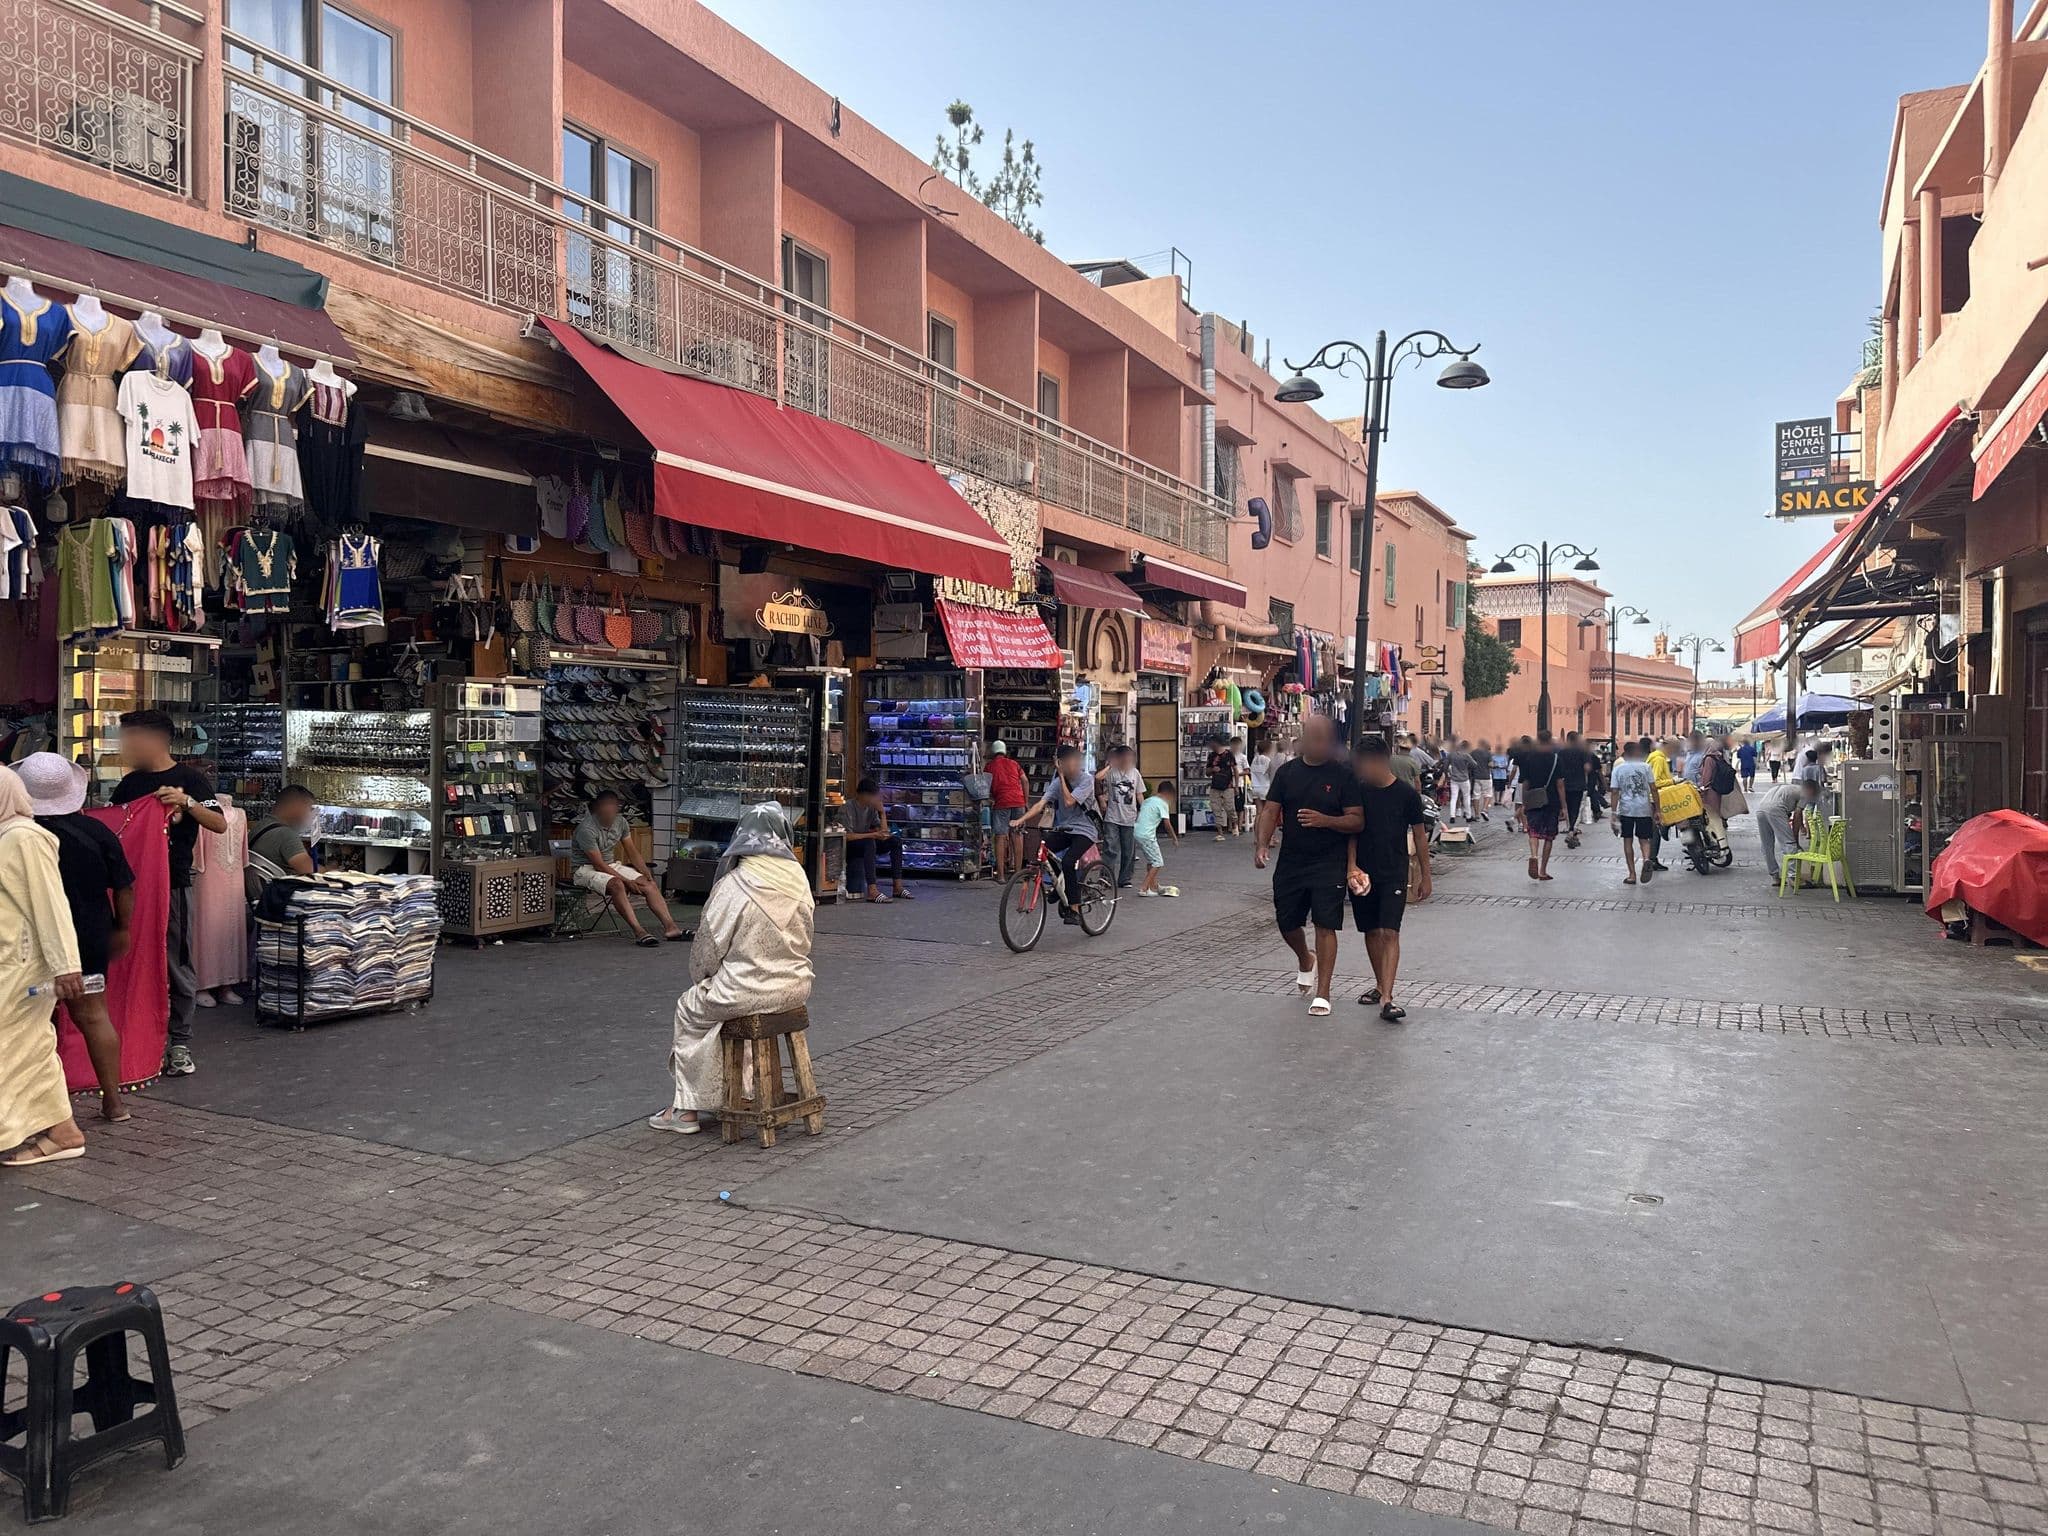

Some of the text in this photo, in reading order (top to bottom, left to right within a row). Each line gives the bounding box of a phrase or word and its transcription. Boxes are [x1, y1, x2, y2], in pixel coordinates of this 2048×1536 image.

[1781, 424, 1826, 440] HÔTEL
[1780, 437, 1825, 449] CENTRAL
[1780, 445, 1825, 457] PALACE
[1780, 487, 1868, 511] SNACK
[769, 610, 800, 627] RACHID
